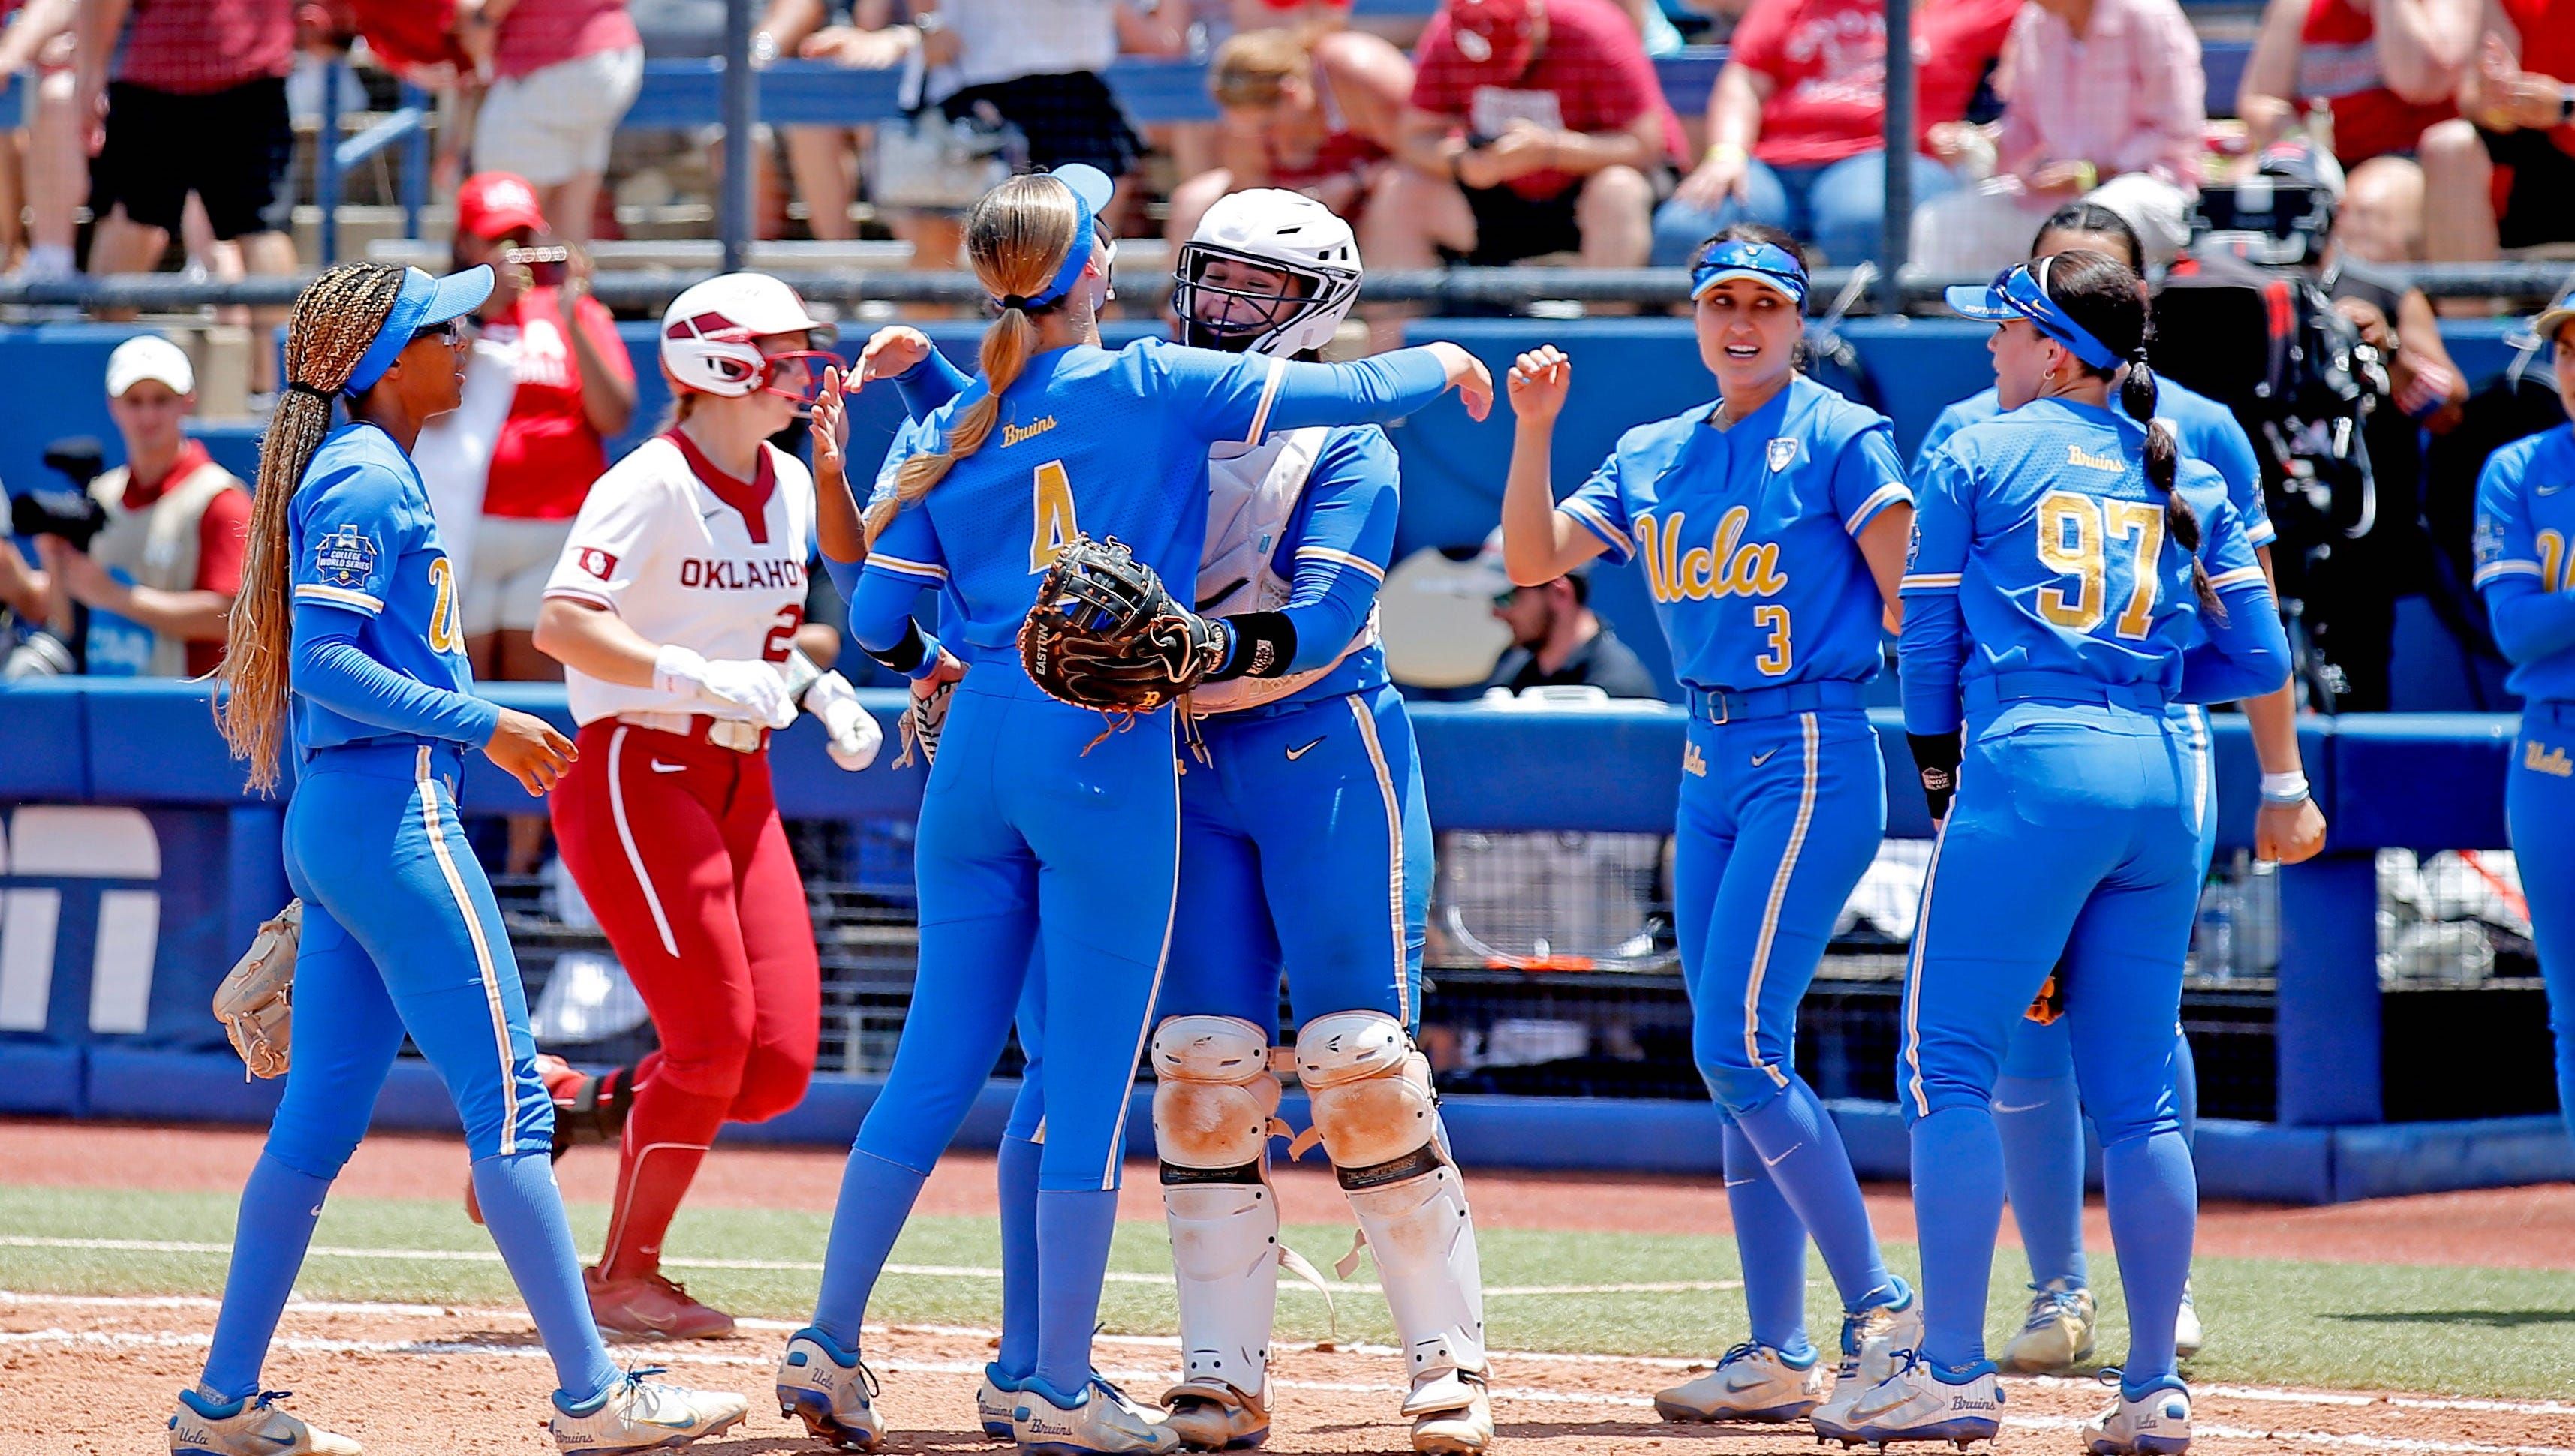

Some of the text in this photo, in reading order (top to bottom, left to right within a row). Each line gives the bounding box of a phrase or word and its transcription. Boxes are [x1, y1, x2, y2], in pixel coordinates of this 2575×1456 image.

[1000, 414, 1057, 448] Bruins
[2067, 444, 2125, 472] Bruins
[1028, 459, 1092, 606] 4
[320, 558, 345, 567] WORLD
[346, 560, 370, 570] SERIES
[330, 550, 362, 561] COLLEGE
[1634, 505, 1788, 603] Ucla
[2035, 489, 2165, 641] 97
[681, 559, 810, 588] OKLAHO
[1036, 623, 1049, 676] EASTON
[1754, 604, 1793, 676] 3
[2525, 740, 2573, 777] Ucla
[1950, 1395, 1996, 1411] Bruins
[179, 1427, 209, 1445] Ucla
[555, 1429, 595, 1443] Bruins
[1028, 1418, 1073, 1436] Bruins
